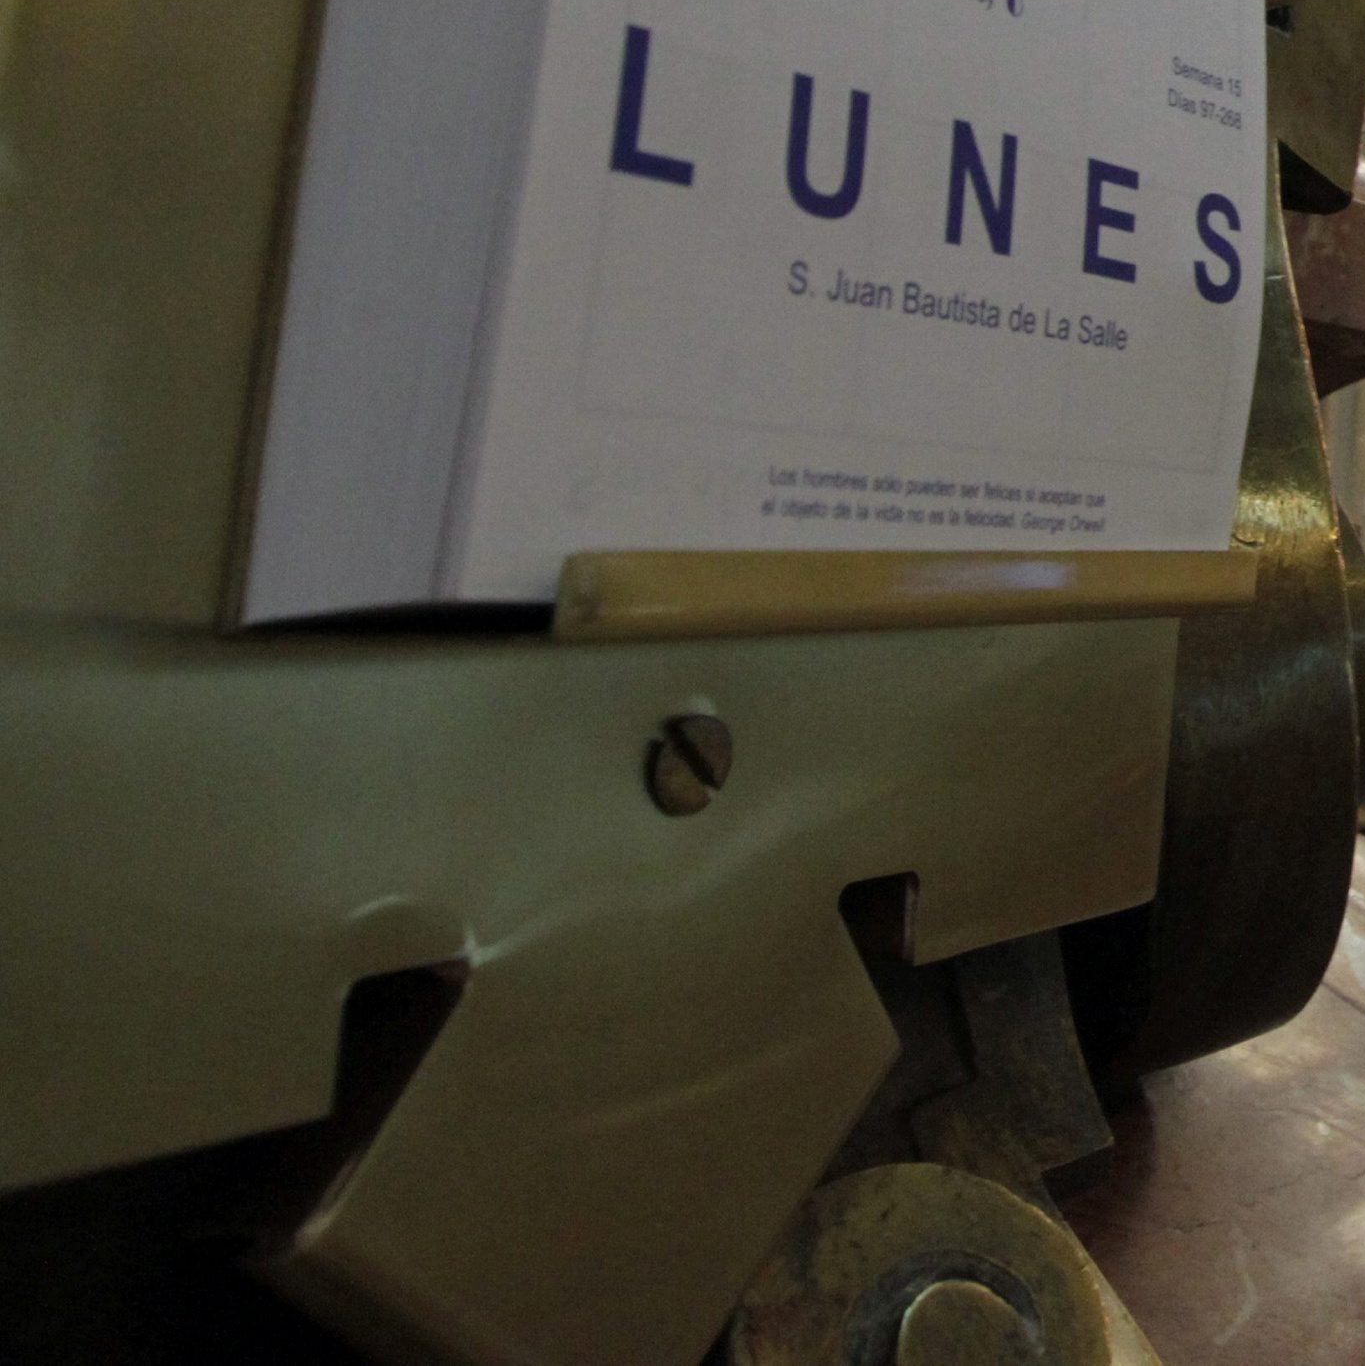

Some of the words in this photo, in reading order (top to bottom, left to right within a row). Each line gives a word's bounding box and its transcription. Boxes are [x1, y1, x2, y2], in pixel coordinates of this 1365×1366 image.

[1172, 56, 1224, 91] Semana
[1228, 78, 1242, 97] 15
[609, 23, 1243, 305] LUNES
[787, 259, 815, 298] S.
[825, 269, 893, 310] Juan
[902, 282, 1001, 329] Bautista
[1009, 303, 1036, 334] de
[1044, 308, 1071, 342] La
[1077, 314, 1129, 351] Salle
